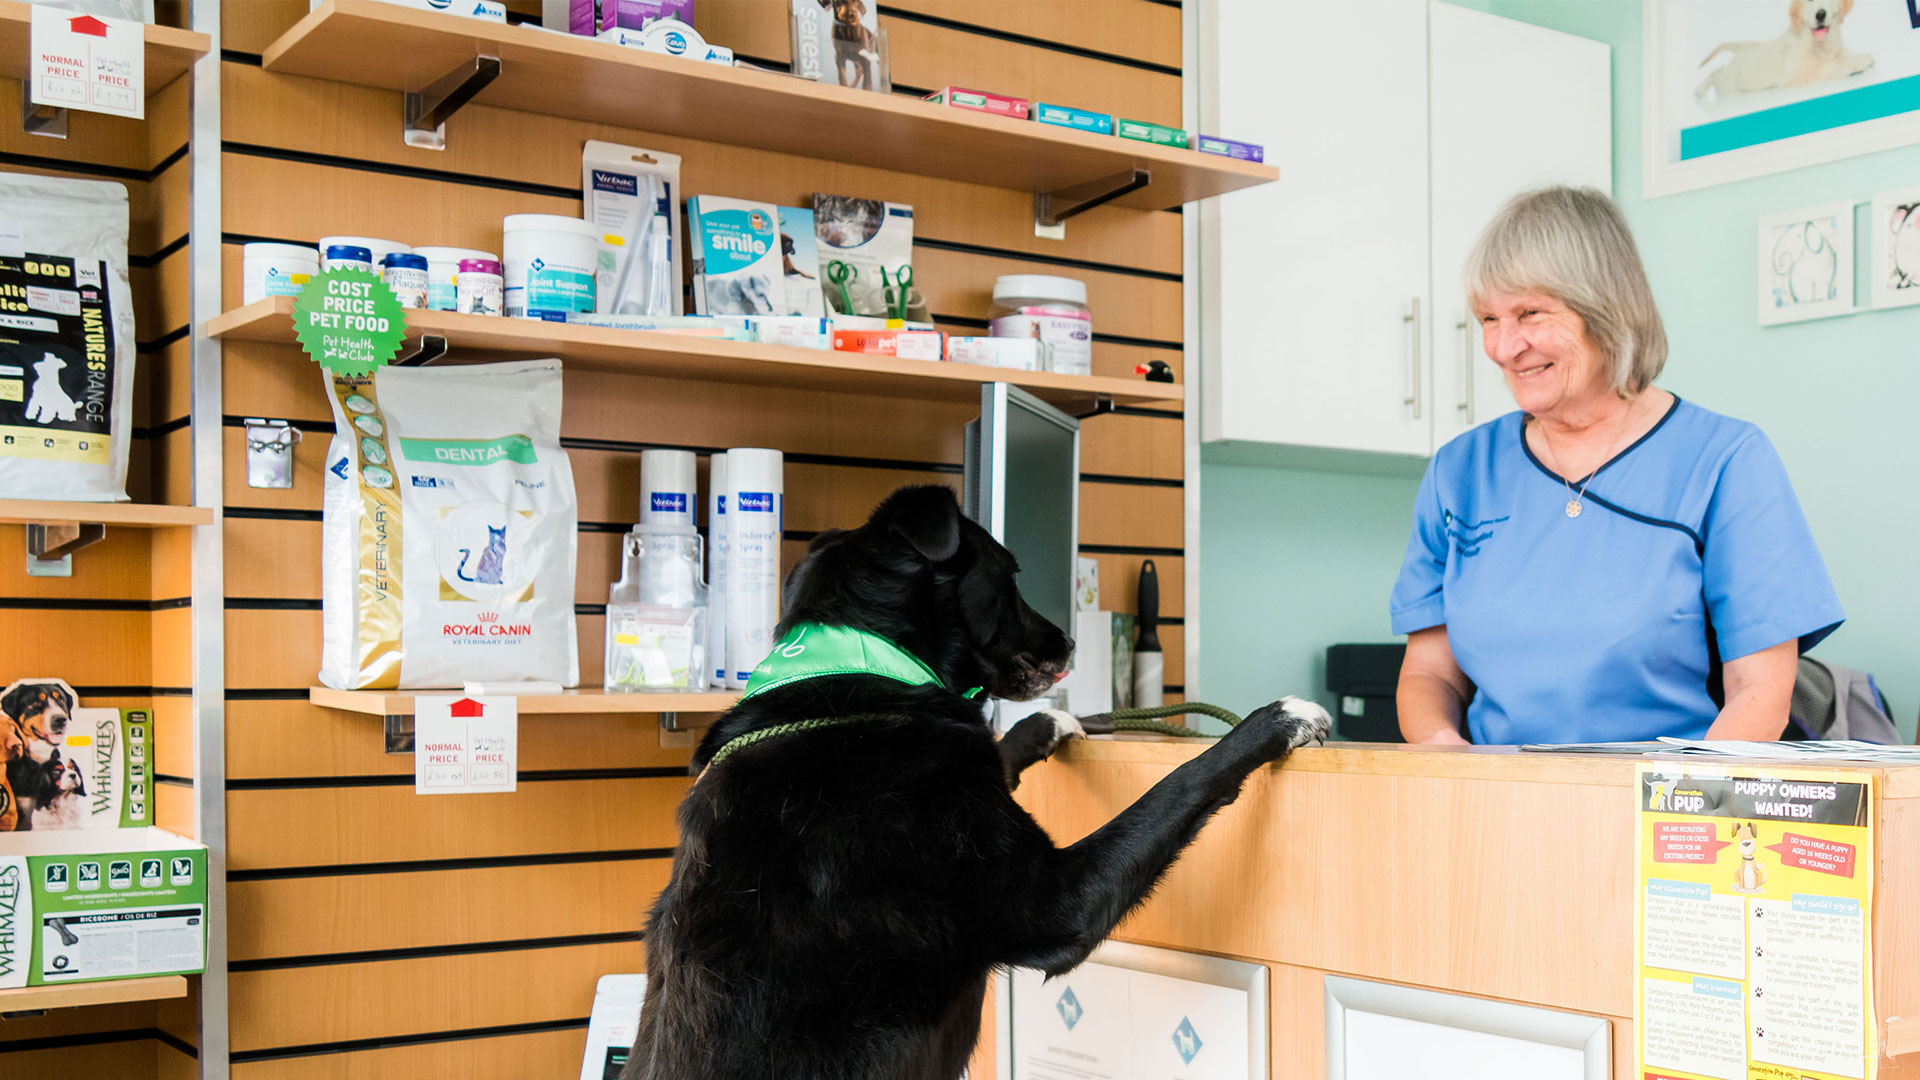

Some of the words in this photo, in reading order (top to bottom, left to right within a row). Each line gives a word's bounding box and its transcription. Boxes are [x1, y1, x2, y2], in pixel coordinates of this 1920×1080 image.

[801, 7, 824, 78] serest
[42, 54, 85, 68] NORMAL
[47, 66, 80, 79] PRICE
[98, 74, 130, 87] PRICE
[595, 172, 636, 186] Virbac
[711, 233, 767, 256] smile
[327, 279, 372, 298] COST
[392, 279, 428, 291] PlaqueO
[531, 277, 554, 288] Joint
[555, 278, 588, 292] Support
[323, 296, 375, 315] PRICE
[310, 311, 341, 329] PET
[344, 314, 389, 333] FOOD
[322, 334, 339, 347] Pet
[340, 336, 375, 350] Health
[348, 349, 375, 362] Club
[434, 444, 508, 462] DENTAL
[653, 498, 685, 507] Virbac
[739, 497, 771, 507] Virbac
[375, 499, 389, 602] VETERINARY
[652, 541, 676, 553] Spray
[739, 541, 764, 553] Spray
[443, 624, 485, 637] ROYAL
[489, 624, 531, 636] CANIN
[452, 638, 502, 646] VETERINARY
[504, 638, 521, 646] DIET
[424, 743, 464, 753] NORMAL
[429, 754, 459, 763] PRICE
[475, 753, 504, 762] PRICE
[92, 720, 115, 816] WHIMZEES
[1674, 788, 1704, 797] Generation
[1734, 780, 1777, 797] PUPPY
[1779, 783, 1837, 800] OWNERS
[1674, 795, 1705, 813] PUP
[1754, 801, 1813, 819] WANTED!
[1790, 837, 1799, 845] DO
[1799, 838, 1810, 847] YOU
[1810, 840, 1825, 850] HAVE
[1830, 844, 1849, 854] PUPPY
[1791, 847, 1806, 856] AGED
[1814, 851, 1833, 861] WEEKS
[1833, 855, 1846, 864] OLD
[1798, 858, 1807, 866] OR
[1807, 859, 1836, 871] YOUNGER?
[80, 914, 119, 923] RICEBONE
